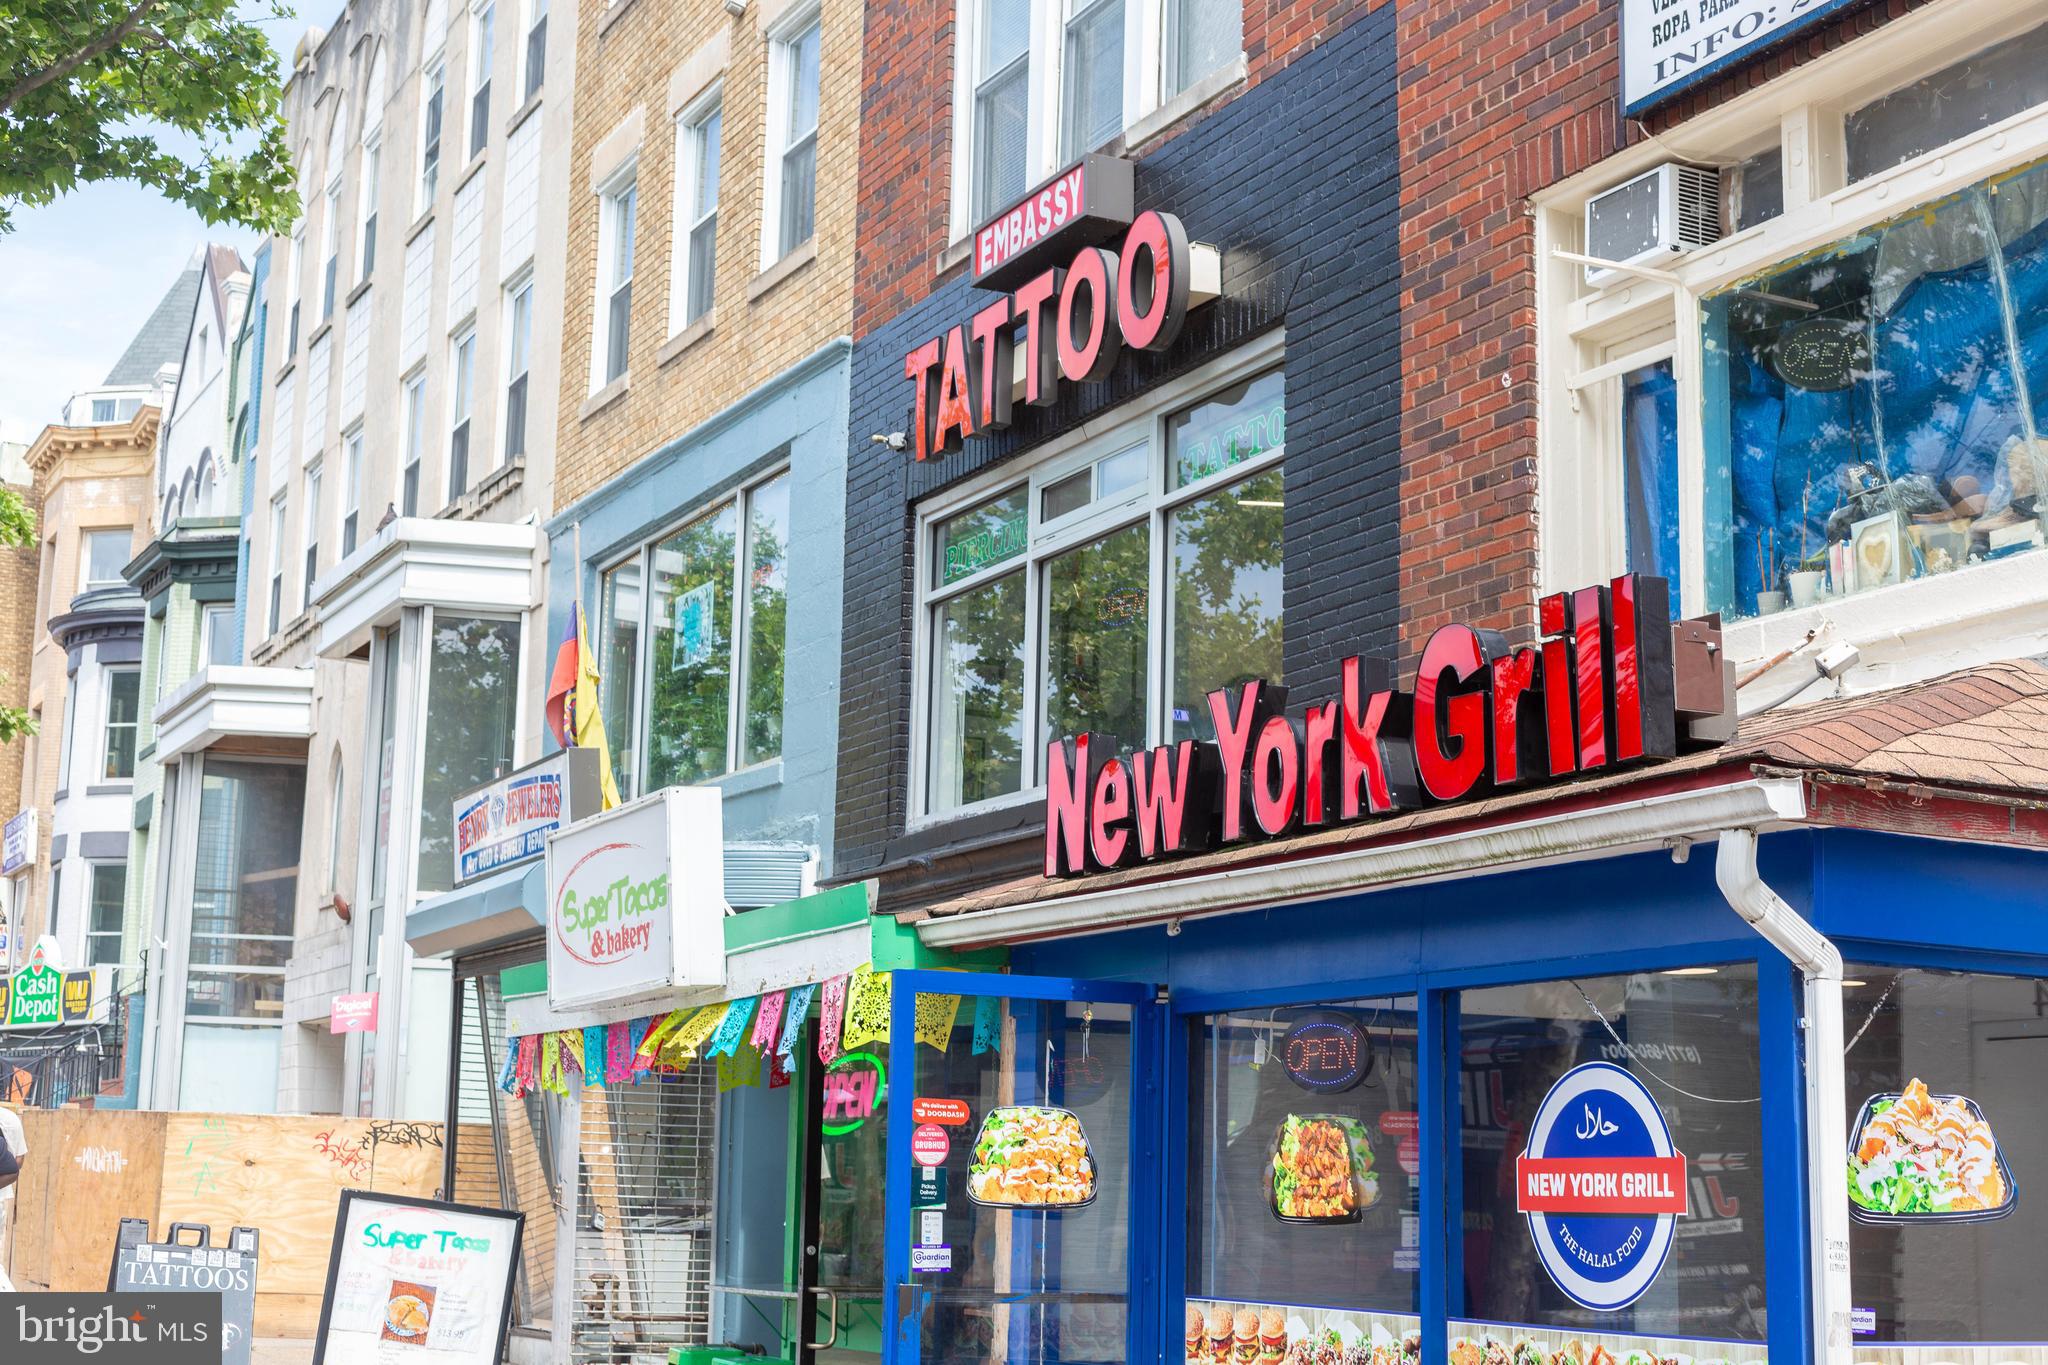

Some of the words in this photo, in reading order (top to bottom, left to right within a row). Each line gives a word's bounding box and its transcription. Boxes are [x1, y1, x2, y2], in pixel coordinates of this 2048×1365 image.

[1652, 9, 1691, 48] ROPA
[1699, 0, 1740, 24] PAR
[1653, 6, 1777, 84] INFO:
[980, 166, 1083, 272] EMBASSY
[905, 210, 1173, 463] TATTOO
[1046, 731, 1195, 877] New
[1206, 652, 1394, 843] York
[1413, 572, 1646, 801] Grill
[459, 804, 489, 853] HENRY
[505, 781, 560, 826] JEWELERS
[563, 889, 611, 941] Super
[608, 873, 668, 917] Tacos
[591, 930, 604, 958] &
[606, 922, 651, 956] bakery
[15, 971, 57, 996] Cash
[15, 995, 58, 1023] Depot
[1288, 1036, 1358, 1072] OPEN
[823, 1070, 877, 1119] OPEN
[927, 1110, 965, 1118] DOORDASH
[1576, 1102, 1620, 1140] حلال
[914, 1140, 946, 1150] GRUBHUB
[1528, 1173, 1567, 1197] NEW
[1570, 1173, 1618, 1198] YORK
[1621, 1173, 1675, 1198] GRILL
[363, 1223, 427, 1250] Super
[1559, 1224, 1579, 1256] THE
[1578, 1249, 1616, 1268] HALAL
[1618, 1225, 1643, 1261] FOOD
[916, 1253, 950, 1261] Guardian
[125, 1262, 249, 1291] TATTOOS
